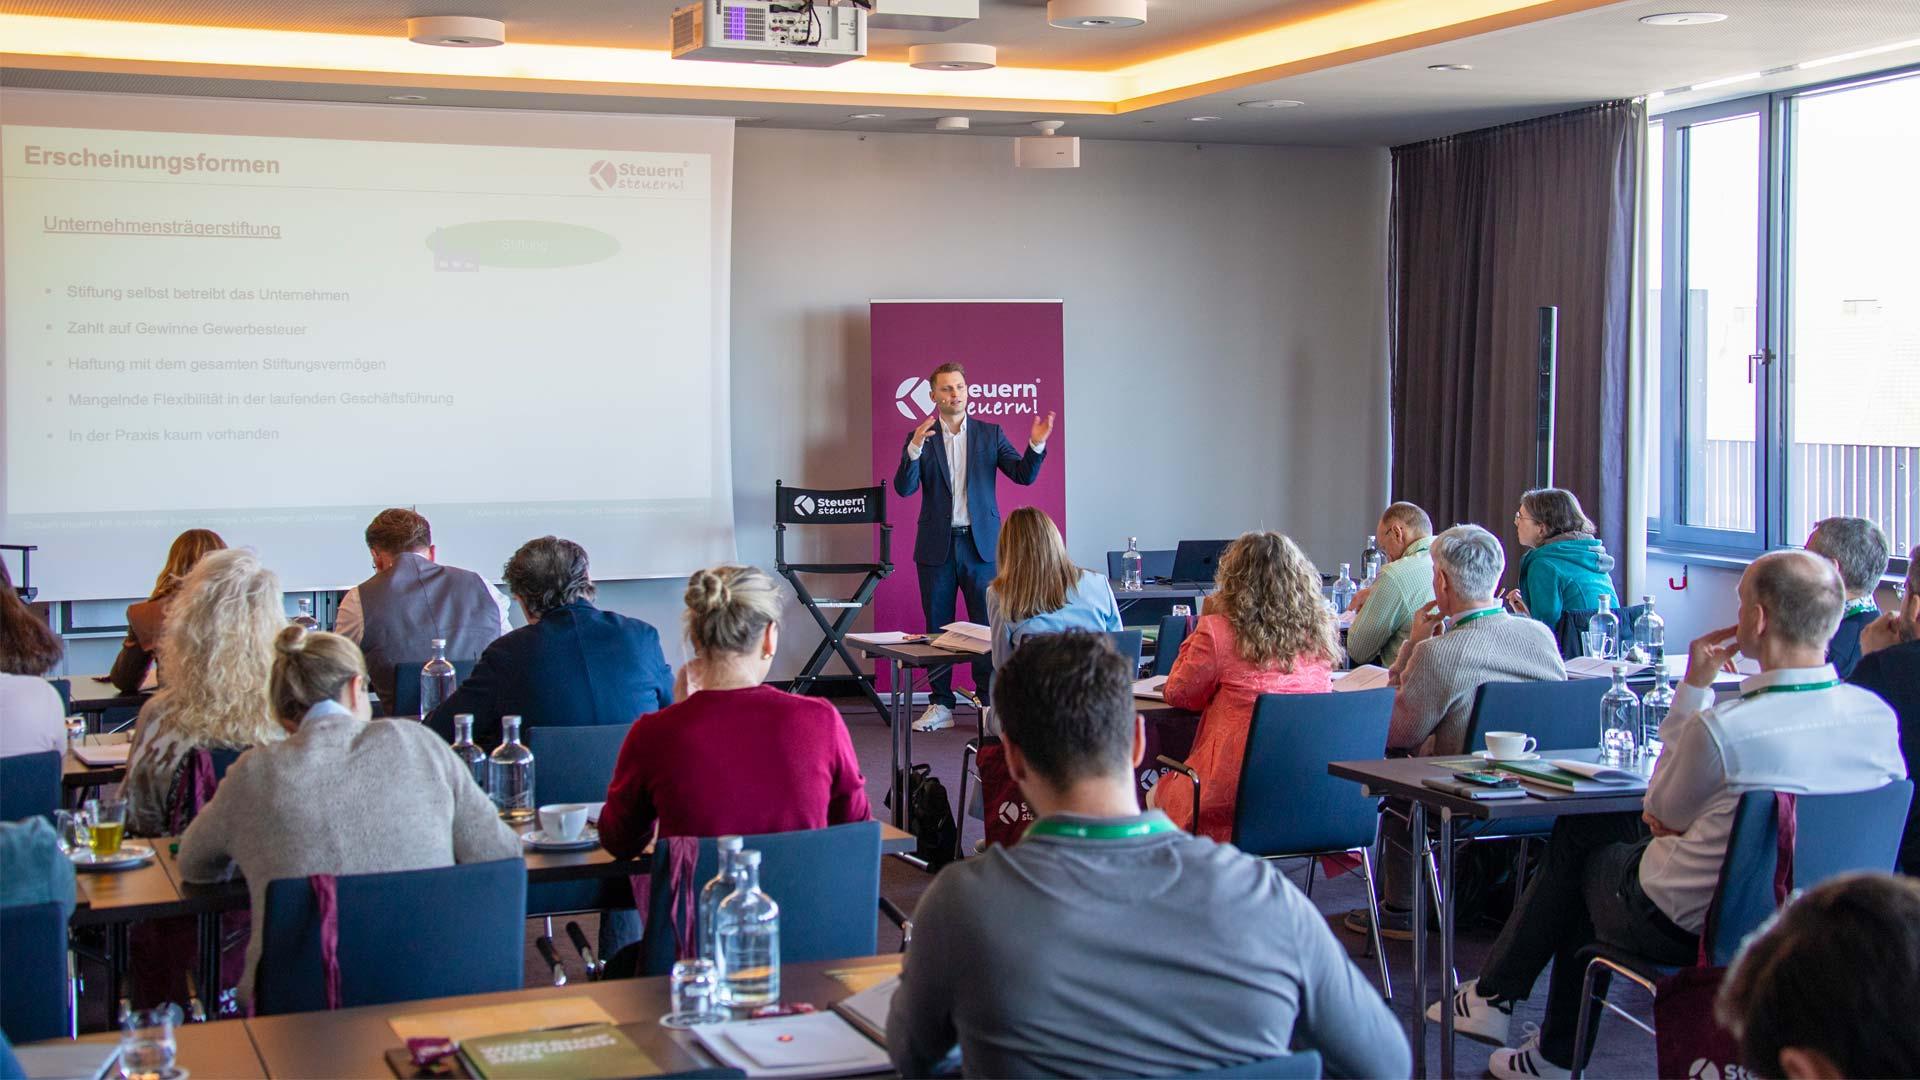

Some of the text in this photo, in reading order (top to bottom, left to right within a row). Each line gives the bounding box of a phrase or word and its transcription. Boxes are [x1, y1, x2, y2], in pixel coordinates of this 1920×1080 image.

[24, 145, 280, 175] Erscheinungsformen
[618, 162, 684, 178] Steuern
[618, 177, 684, 191] steuern!
[43, 215, 281, 238] Unternehmensträgerstiftung
[66, 285, 350, 301] Stiftung selbst betreibt das Unternehmen
[66, 321, 307, 336] Zahlt auf Gewinne Gewerbesteuer
[68, 357, 386, 373] Haftung mit dem gesamten Stiftungsvermögen
[968, 383, 1038, 398] euern
[68, 391, 454, 409] Mangelnde Flexibilität in der laufenden Geschäftsführung
[967, 399, 1038, 416] euern!
[69, 427, 279, 442] In der Praxis kaum vorhanden
[817, 497, 865, 507] Steuern
[817, 505, 866, 515] steuern!
